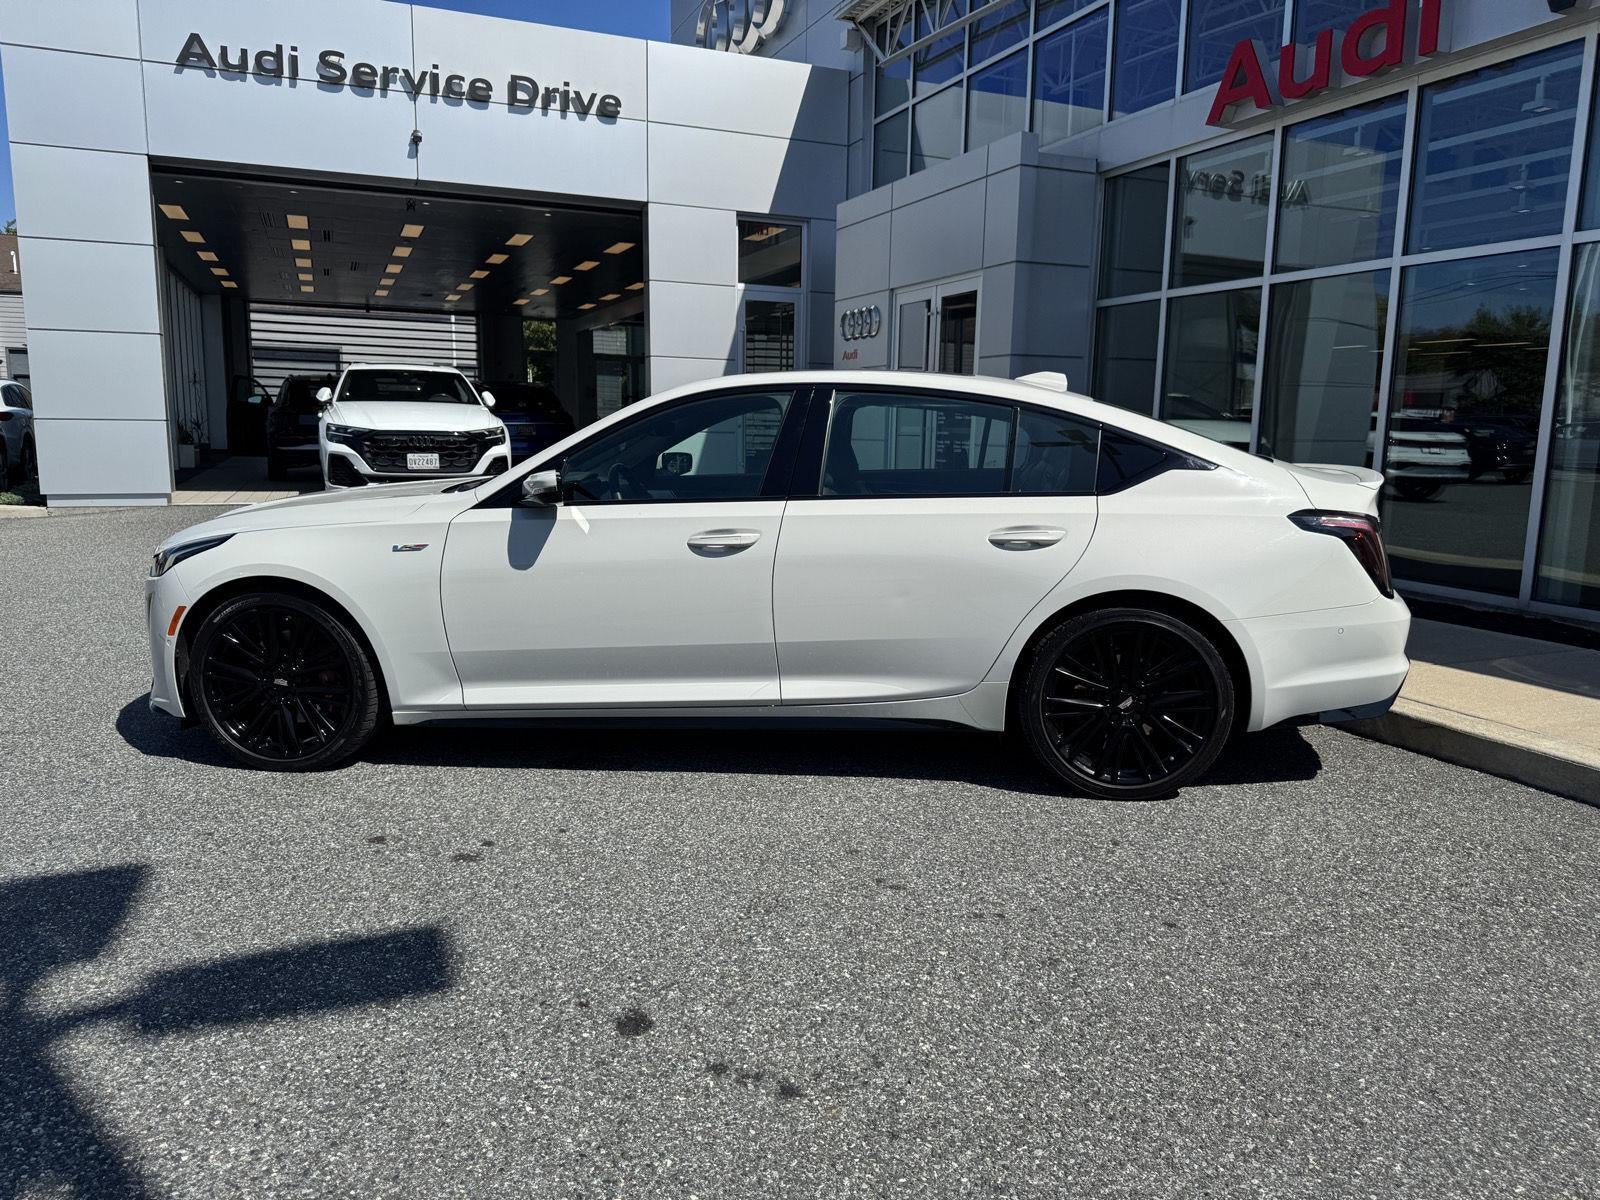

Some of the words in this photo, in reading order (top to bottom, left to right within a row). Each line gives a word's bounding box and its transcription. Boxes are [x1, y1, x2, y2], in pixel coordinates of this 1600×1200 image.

[176, 33, 299, 78] Audi
[318, 50, 493, 101] Service
[508, 75, 622, 117] Drive
[842, 349, 859, 361] Audi
